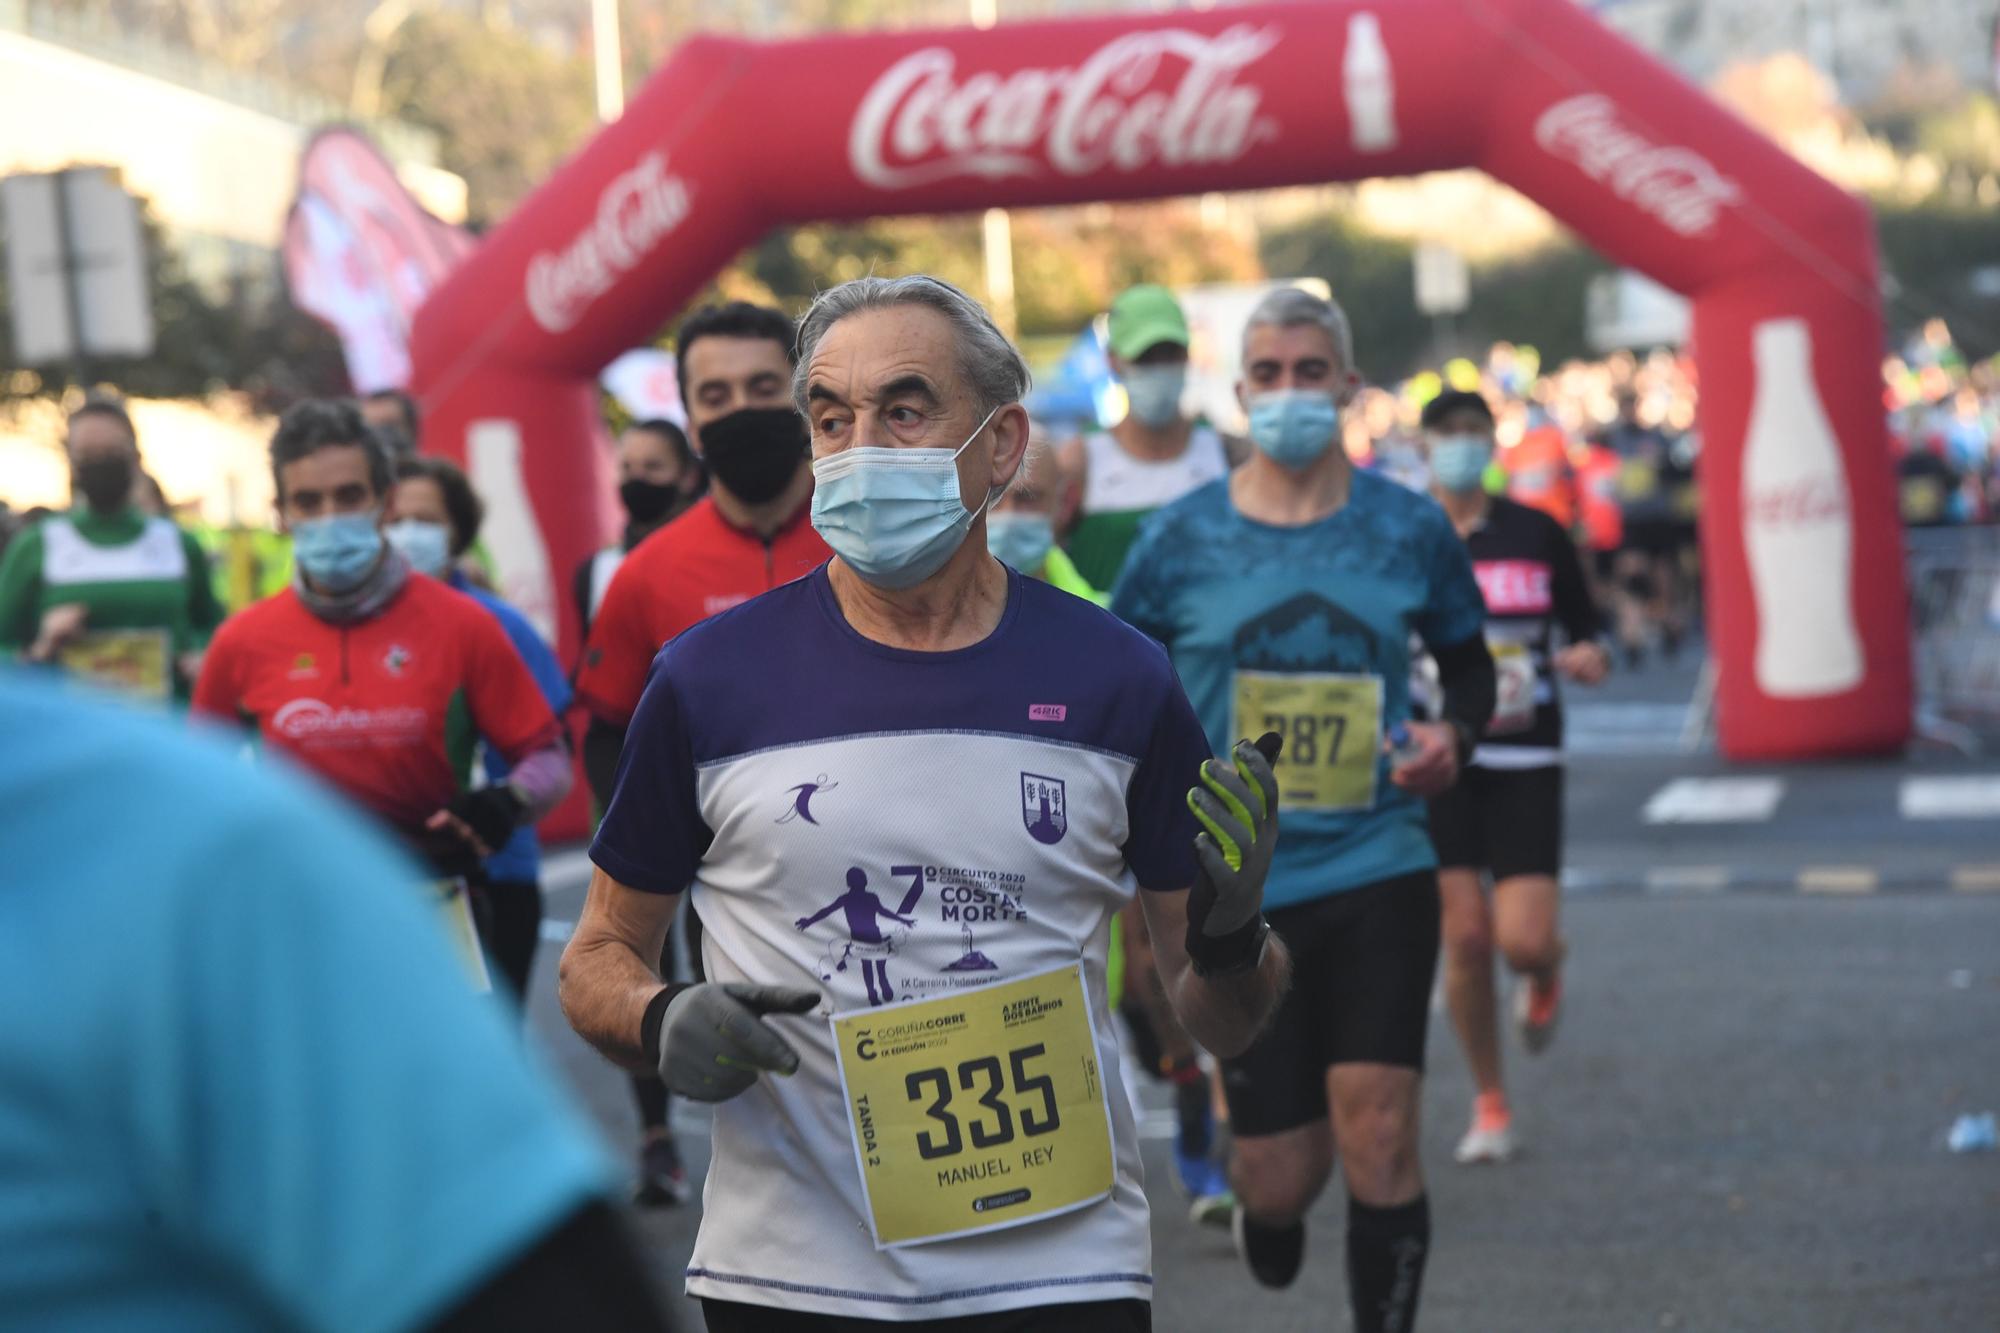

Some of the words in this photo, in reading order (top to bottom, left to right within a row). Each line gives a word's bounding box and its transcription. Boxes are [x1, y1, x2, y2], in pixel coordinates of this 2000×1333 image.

[939, 866, 997, 881] CIRCUITO
[998, 873, 1026, 883] 2020
[939, 876, 997, 889] CORRENDO
[999, 882, 1024, 893] POLA
[940, 887, 1016, 909] COSTA
[941, 904, 1028, 923] MORTE
[1003, 1010, 1024, 1022] DOS
[1024, 998, 1063, 1016] BARRIOS
[1011, 996, 1040, 1010] XENTE
[891, 1042, 926, 1056] EDICIÓN
[904, 1042, 1061, 1160] 335
[857, 1094, 877, 1152] TANDA
[868, 1155, 881, 1168] 2
[937, 1158, 1011, 1188] MANUEL
[1022, 1144, 1054, 1169] REY
